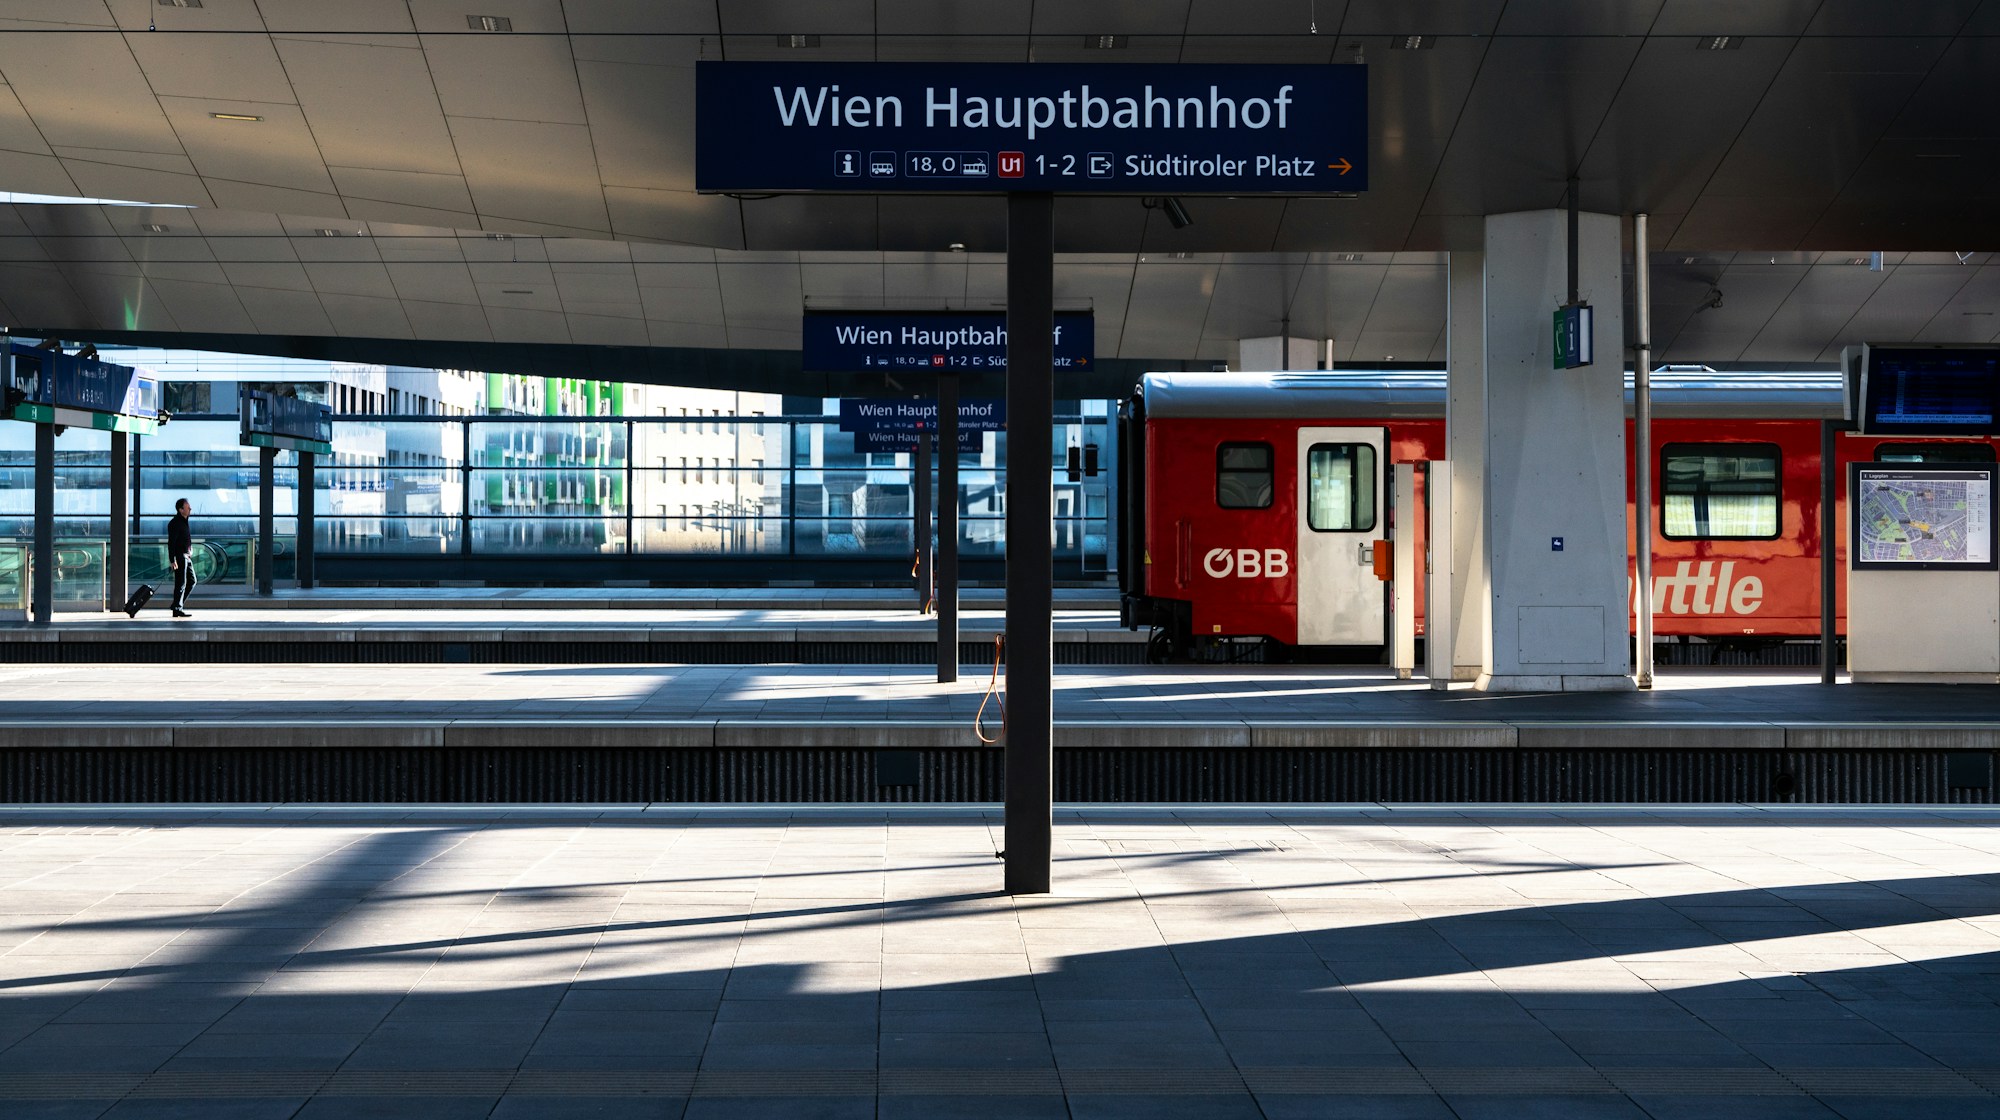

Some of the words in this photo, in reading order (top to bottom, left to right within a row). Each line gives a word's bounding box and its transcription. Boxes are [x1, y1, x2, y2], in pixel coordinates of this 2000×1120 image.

[773, 85, 902, 128] Wien
[926, 85, 1294, 140] Hauptbahnhof
[911, 157, 937, 174] 18,
[1002, 158, 1021, 172] U1
[1035, 154, 1076, 176] 1-2
[1125, 154, 1247, 176] Südtiroler
[1256, 154, 1315, 176] Platz
[836, 326, 893, 345] Wien
[901, 325, 1062, 350] Hauptbahf
[934, 356, 944, 365] U1
[949, 356, 967, 366] 1-2
[859, 404, 893, 416] Wien
[898, 403, 993, 419] Hauptnhof
[982, 421, 998, 429] Platz
[869, 432, 894, 442] Wien
[1203, 548, 1289, 578] ÖBB
